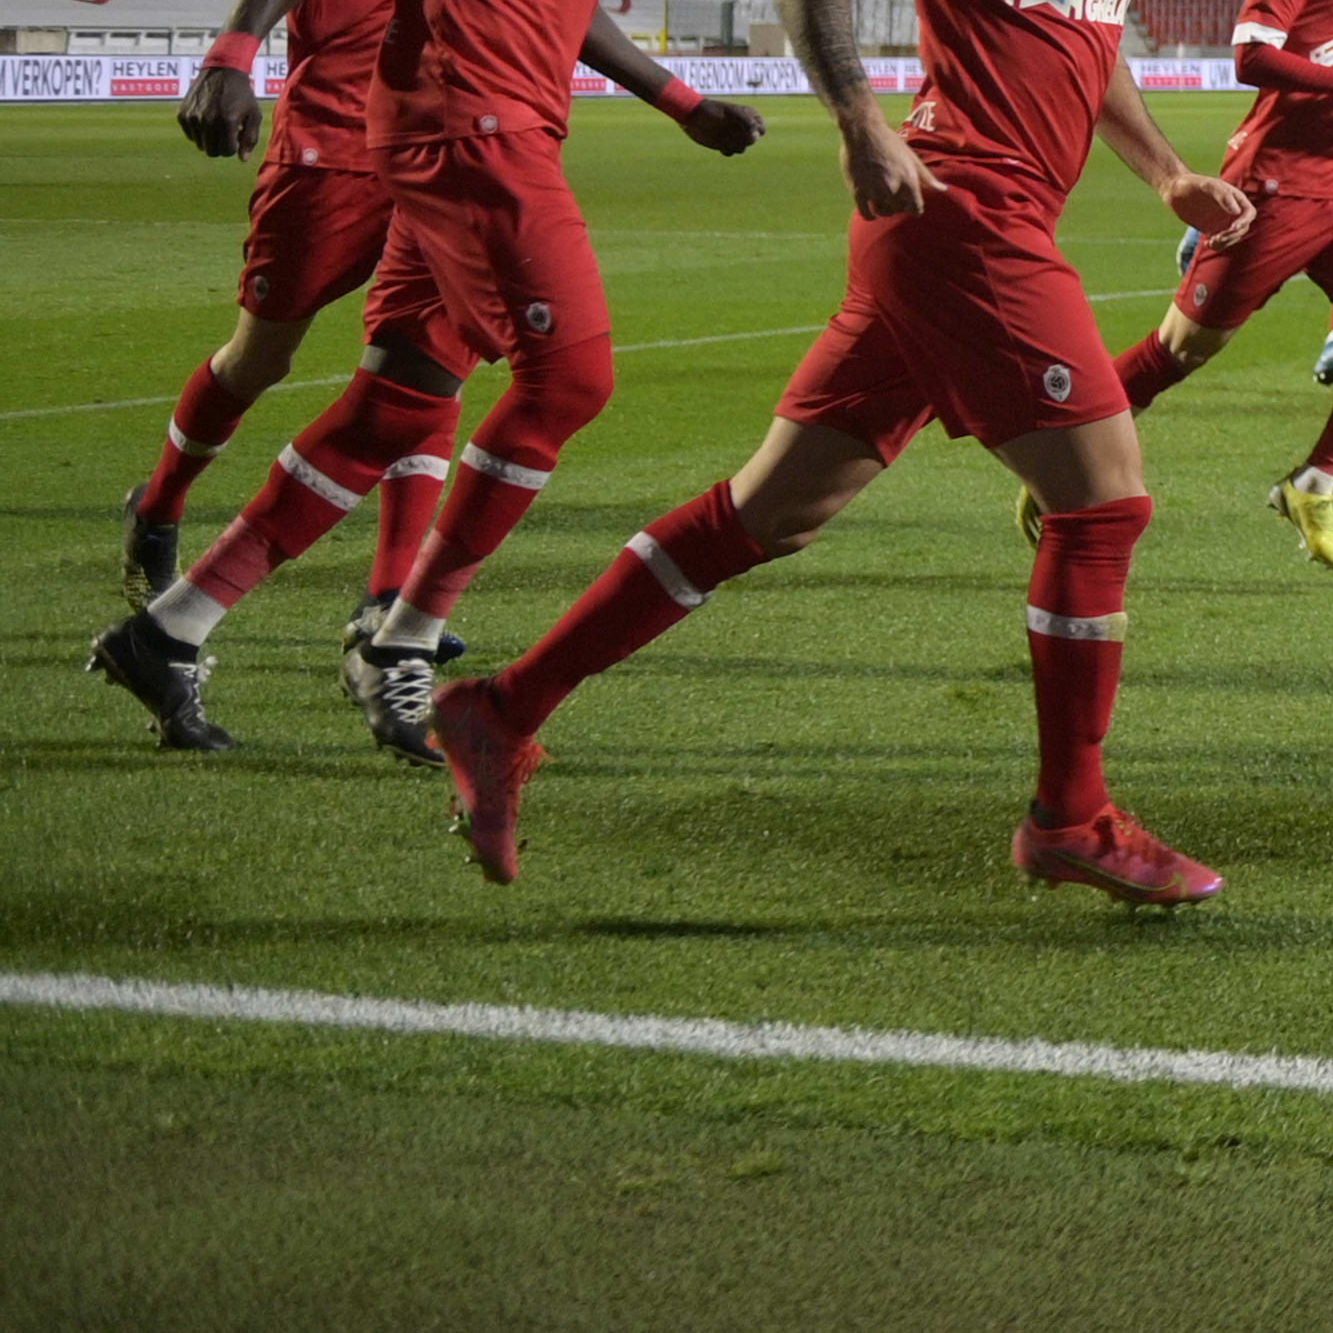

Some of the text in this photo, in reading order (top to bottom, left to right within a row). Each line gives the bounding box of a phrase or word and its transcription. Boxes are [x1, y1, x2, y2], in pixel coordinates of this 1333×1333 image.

[112, 61, 179, 77] HEYLEN
[12, 59, 102, 97] VERKOPEN?
[112, 82, 178, 93] VASTGOED
